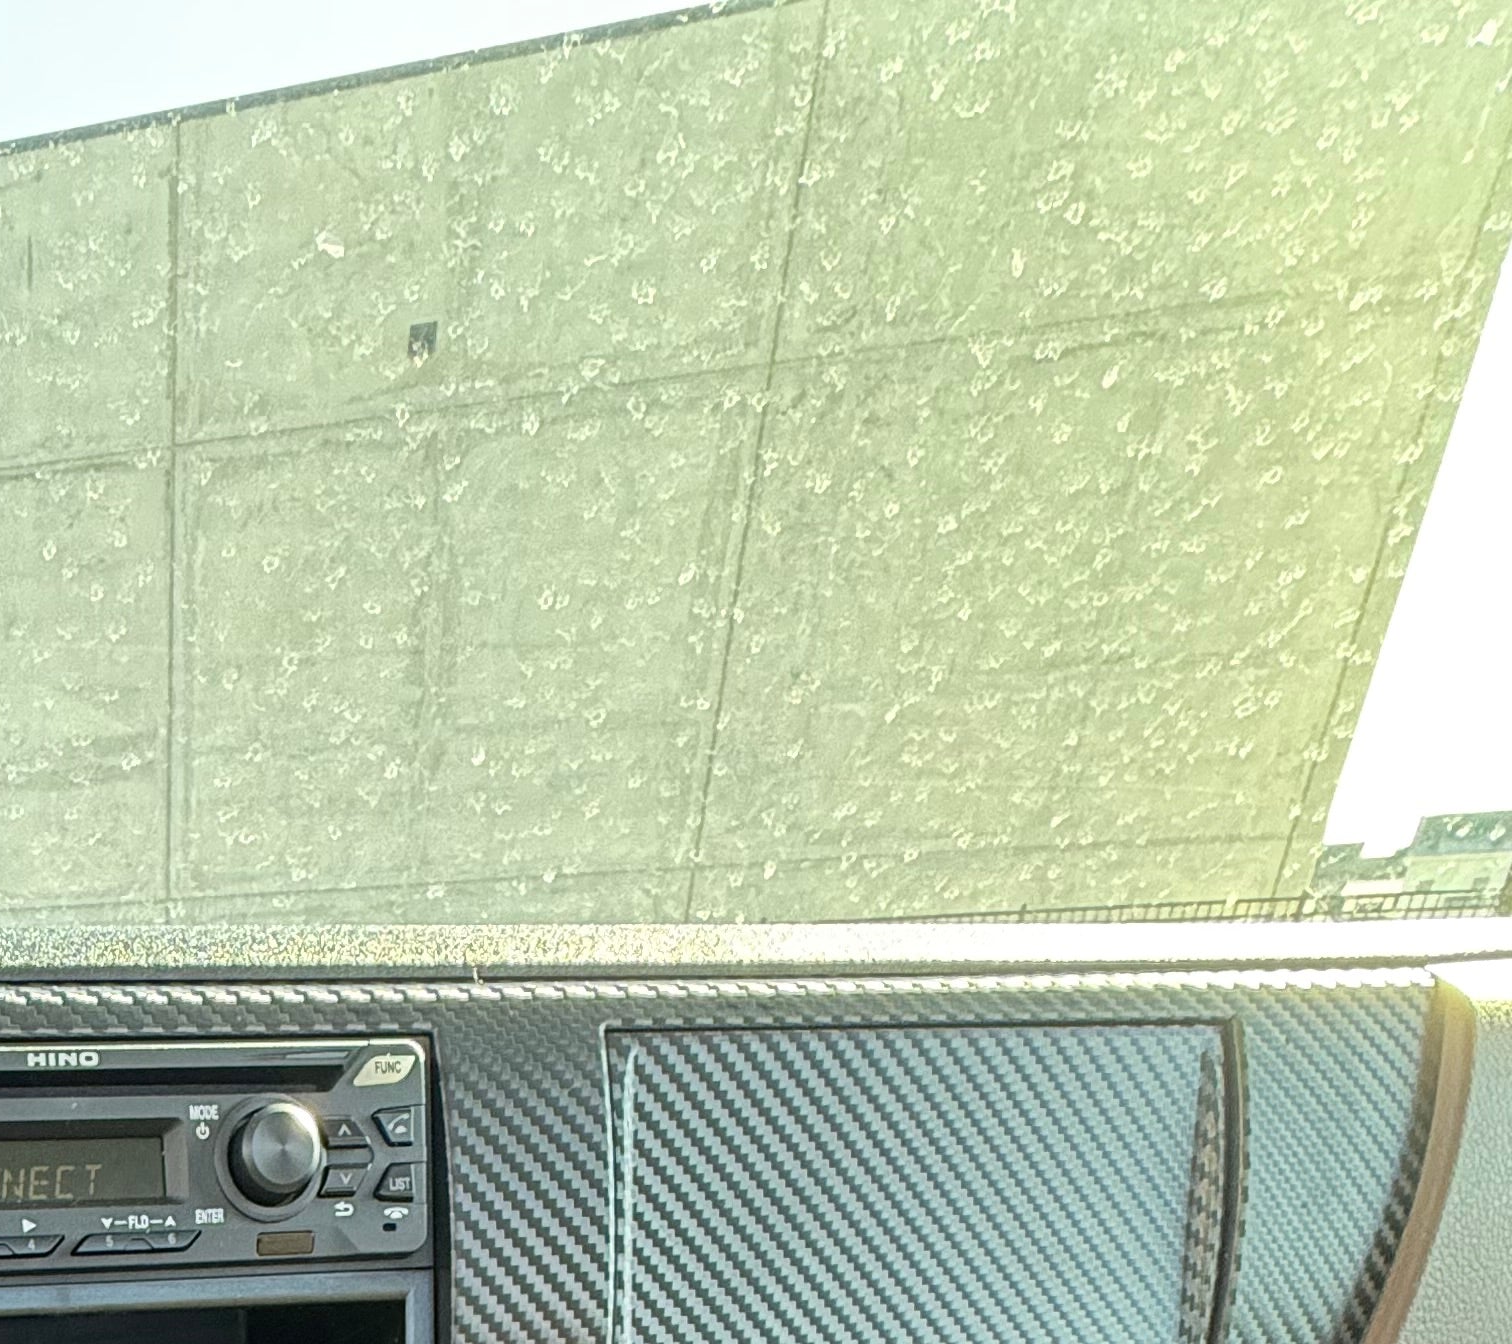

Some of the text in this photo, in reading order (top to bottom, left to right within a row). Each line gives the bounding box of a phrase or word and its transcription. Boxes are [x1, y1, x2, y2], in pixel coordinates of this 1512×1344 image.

[27, 1051, 99, 1067] HINO
[374, 1061, 402, 1074] FUNC
[189, 1104, 218, 1121] MODE
[389, 1177, 411, 1192] LIST
[195, 1208, 225, 1225] ENTER
[27, 1238, 36, 1250] 4
[105, 1235, 114, 1248] 5
[168, 1232, 176, 1245] 6
